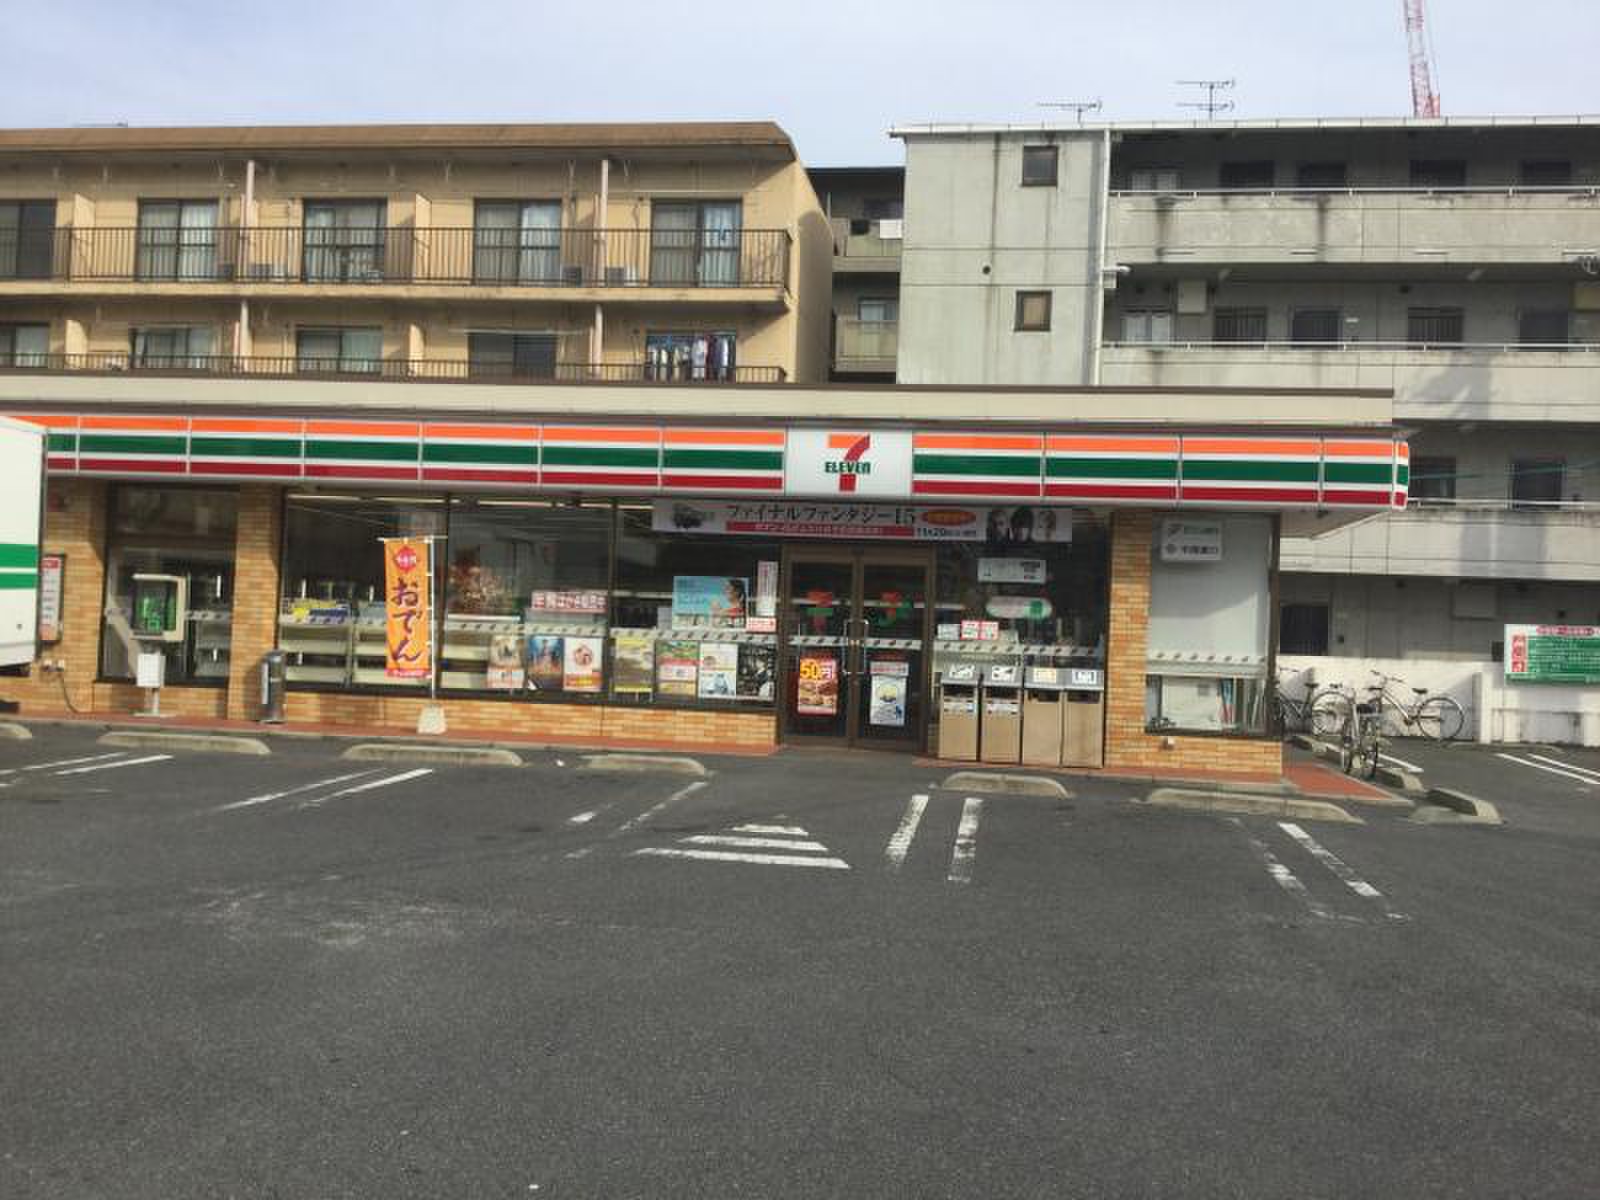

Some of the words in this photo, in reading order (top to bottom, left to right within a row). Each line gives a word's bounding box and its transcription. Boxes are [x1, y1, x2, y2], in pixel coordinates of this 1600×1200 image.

[829, 433, 870, 492] 7
[391, 576, 422, 661] おでん
